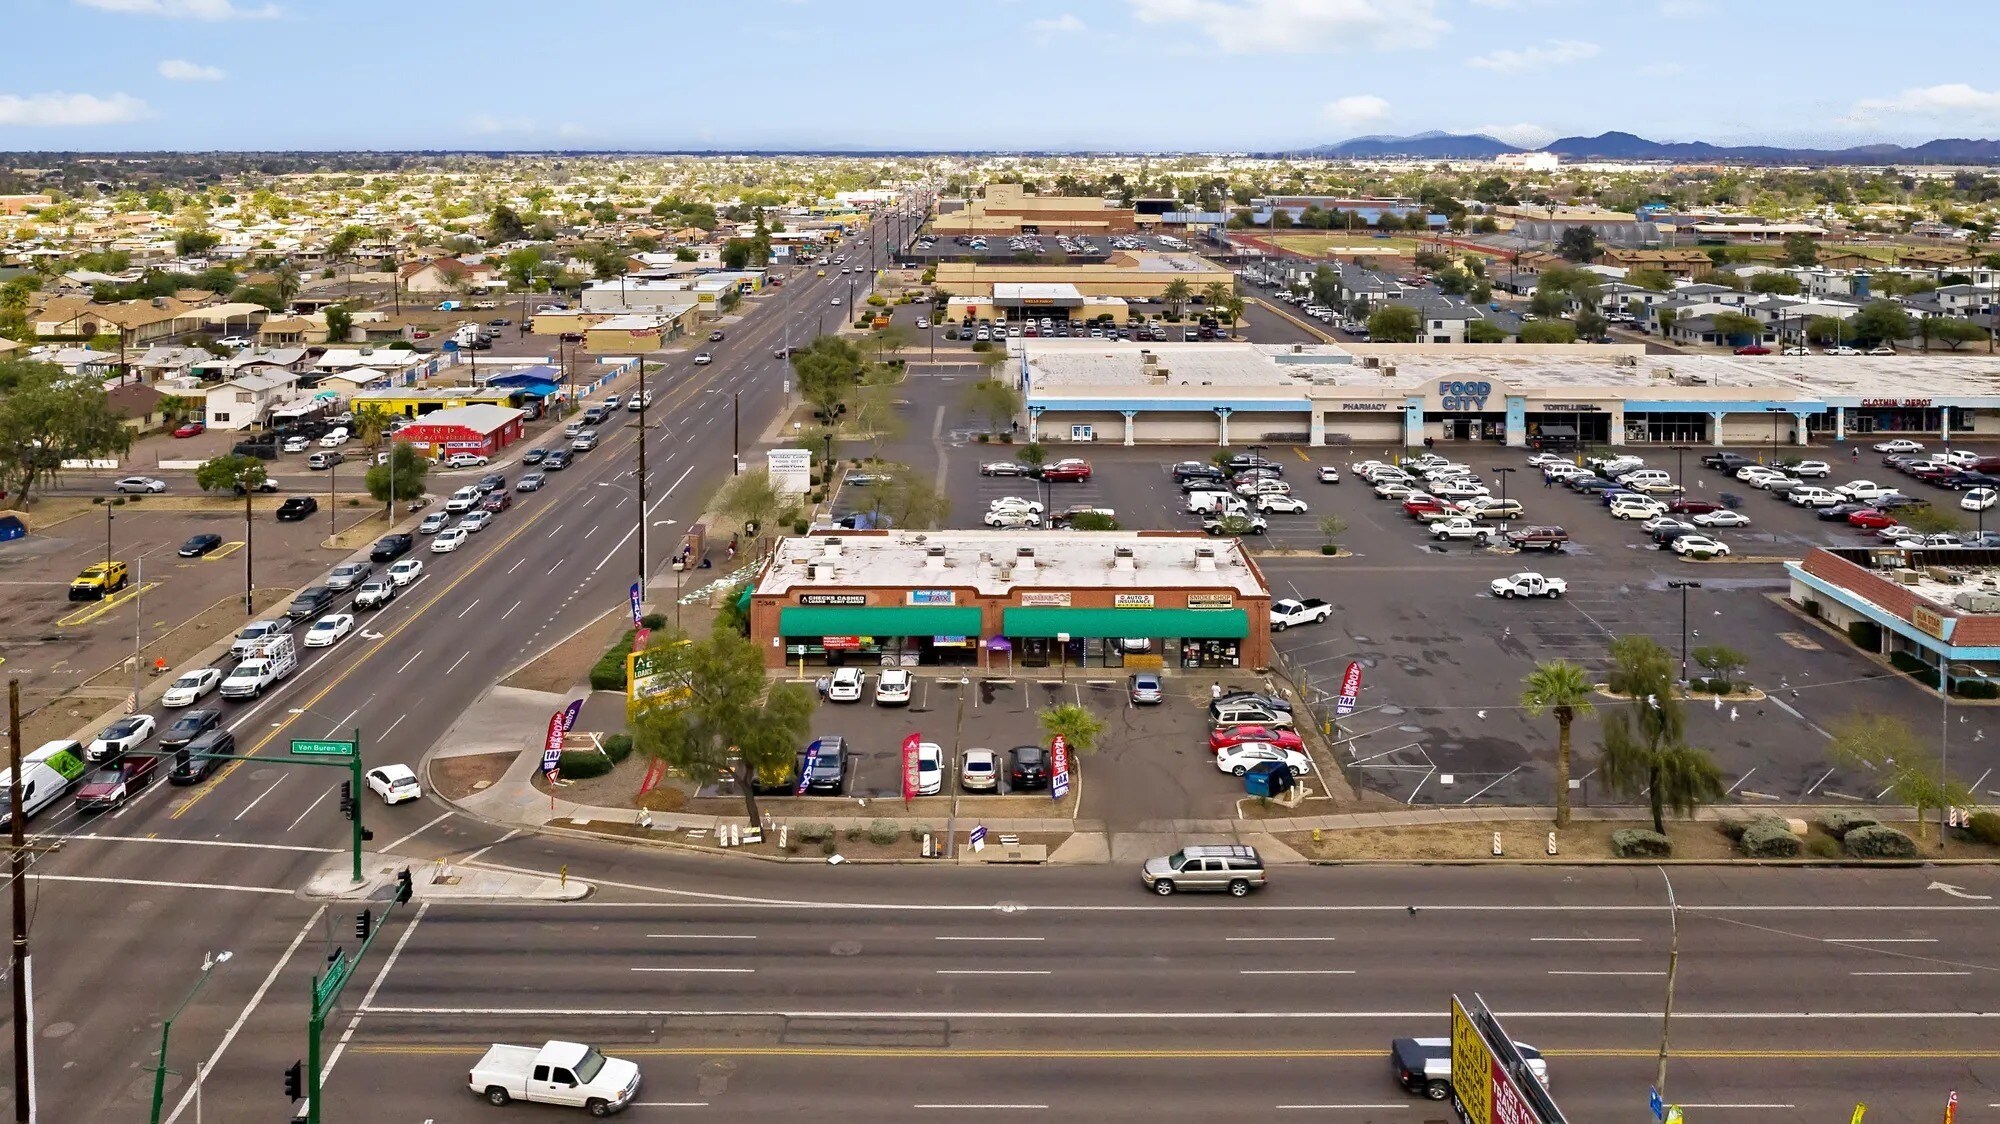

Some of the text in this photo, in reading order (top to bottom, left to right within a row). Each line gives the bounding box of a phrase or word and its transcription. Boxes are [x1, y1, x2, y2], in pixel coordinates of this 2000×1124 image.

[1439, 381, 1492, 396] FOOD
[1342, 403, 1387, 411] PHARMACY
[1442, 396, 1488, 411] CITY
[1905, 398, 1932, 407] DEPOT
[1340, 697, 1354, 705] TAX
[564, 709, 576, 731] metro
[1054, 773, 1068, 786] TAX
[1458, 1044, 1485, 1091] MOTOR
[1457, 1056, 1486, 1109] VEHICLE
[1502, 1080, 1518, 1110] GET
